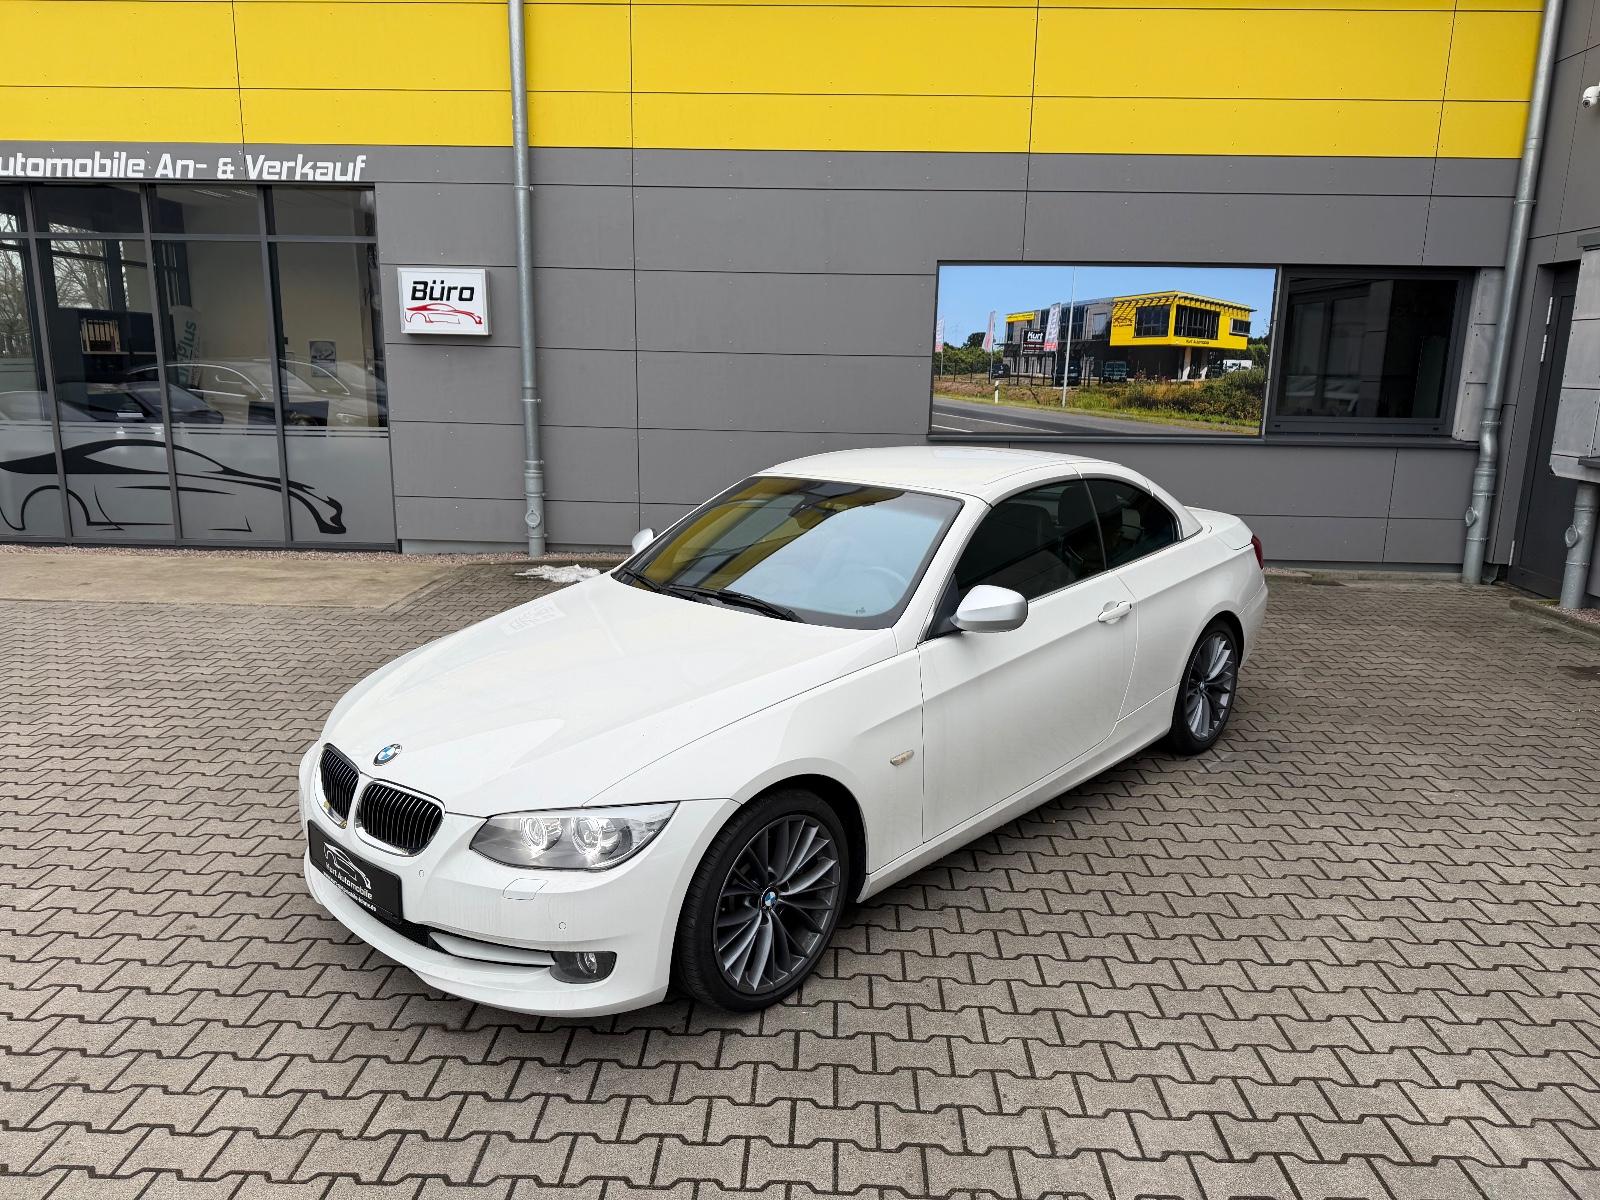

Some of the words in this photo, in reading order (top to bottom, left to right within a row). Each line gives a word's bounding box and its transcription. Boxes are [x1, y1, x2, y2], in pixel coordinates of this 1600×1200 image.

[154, 153, 207, 179] An-
[217, 157, 235, 179] &
[245, 153, 367, 182] Verkauf
[410, 280, 475, 302] Büro
